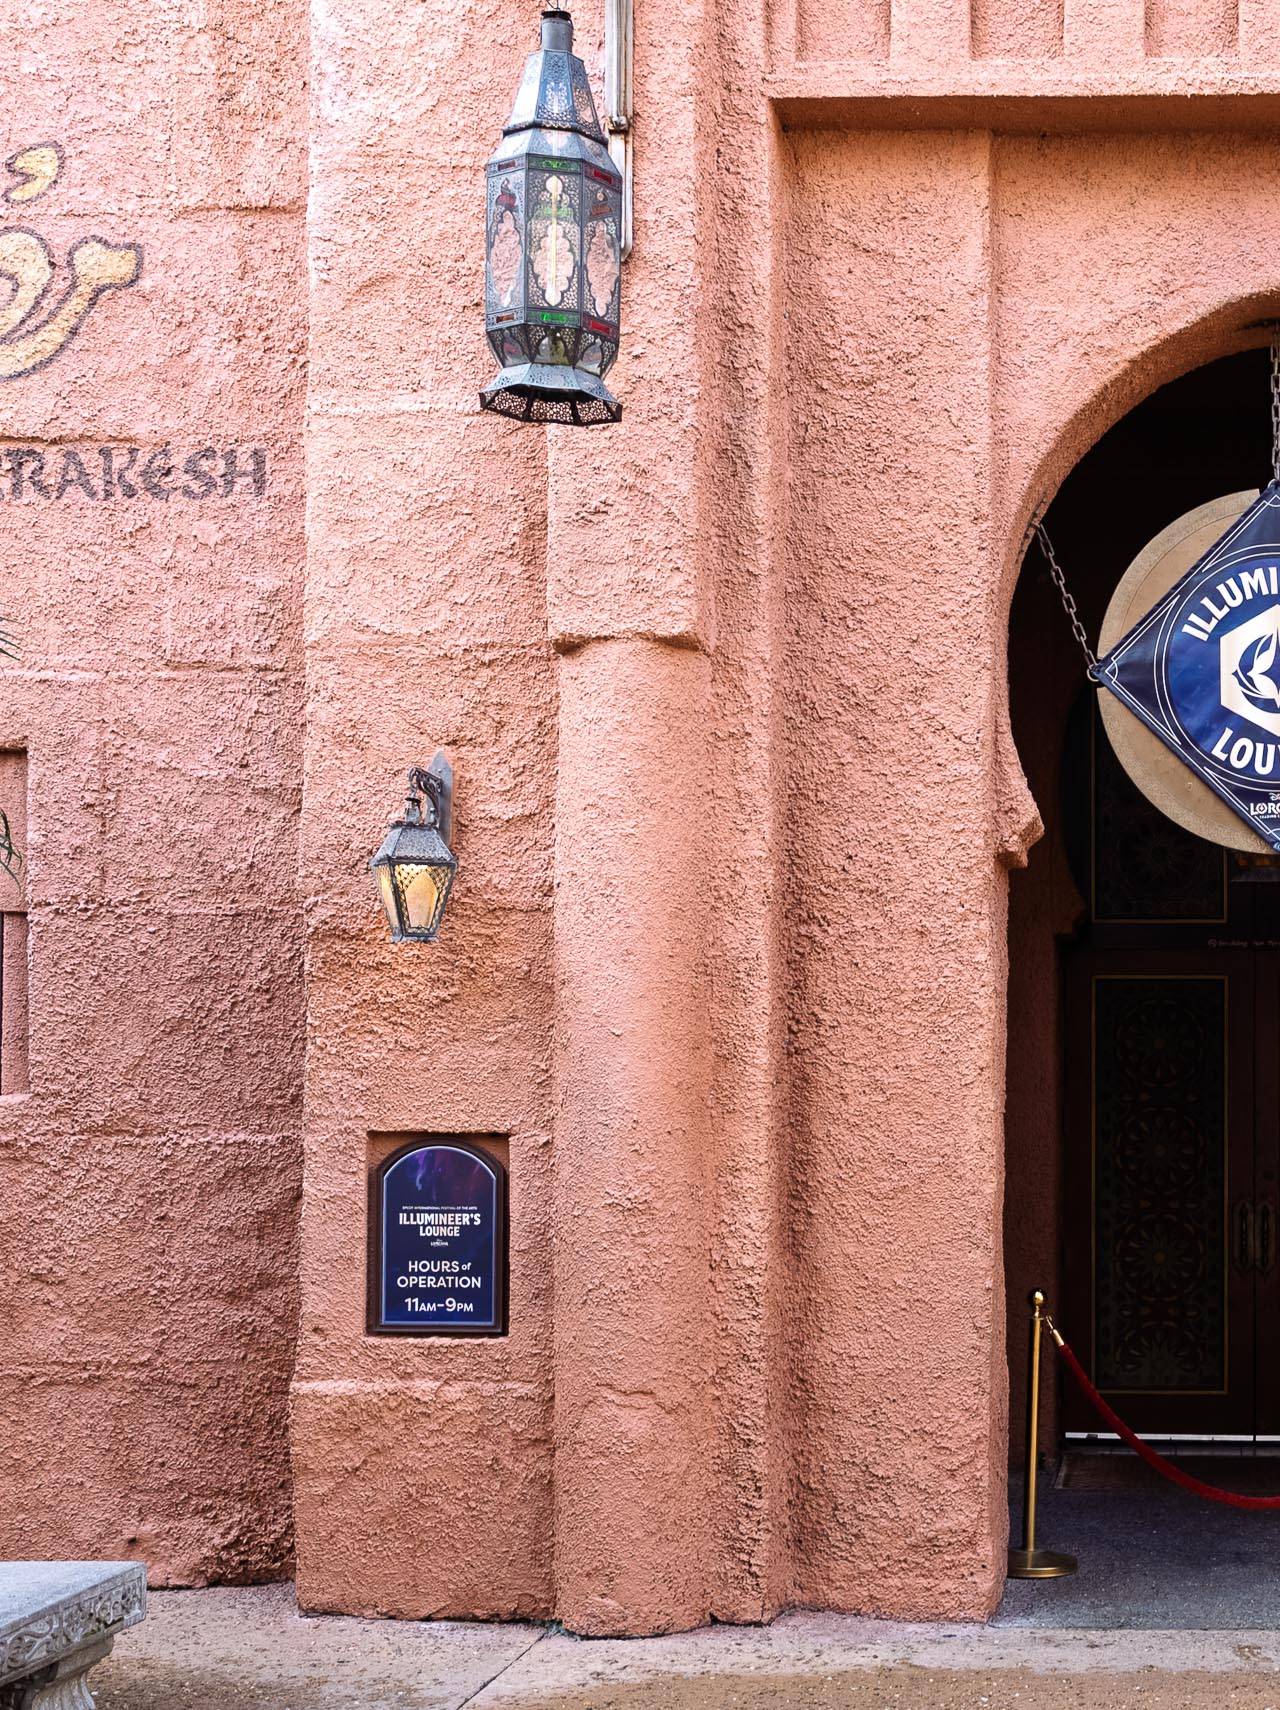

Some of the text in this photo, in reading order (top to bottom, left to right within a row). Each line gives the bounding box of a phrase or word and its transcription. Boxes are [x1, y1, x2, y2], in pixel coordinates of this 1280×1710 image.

[0, 446, 267, 501] RAKESH
[399, 1213, 481, 1225] ILLUMINEER'S
[419, 1226, 460, 1236] LOUNGE
[408, 1261, 471, 1273] HOURS of
[396, 1276, 481, 1289] OPERATION
